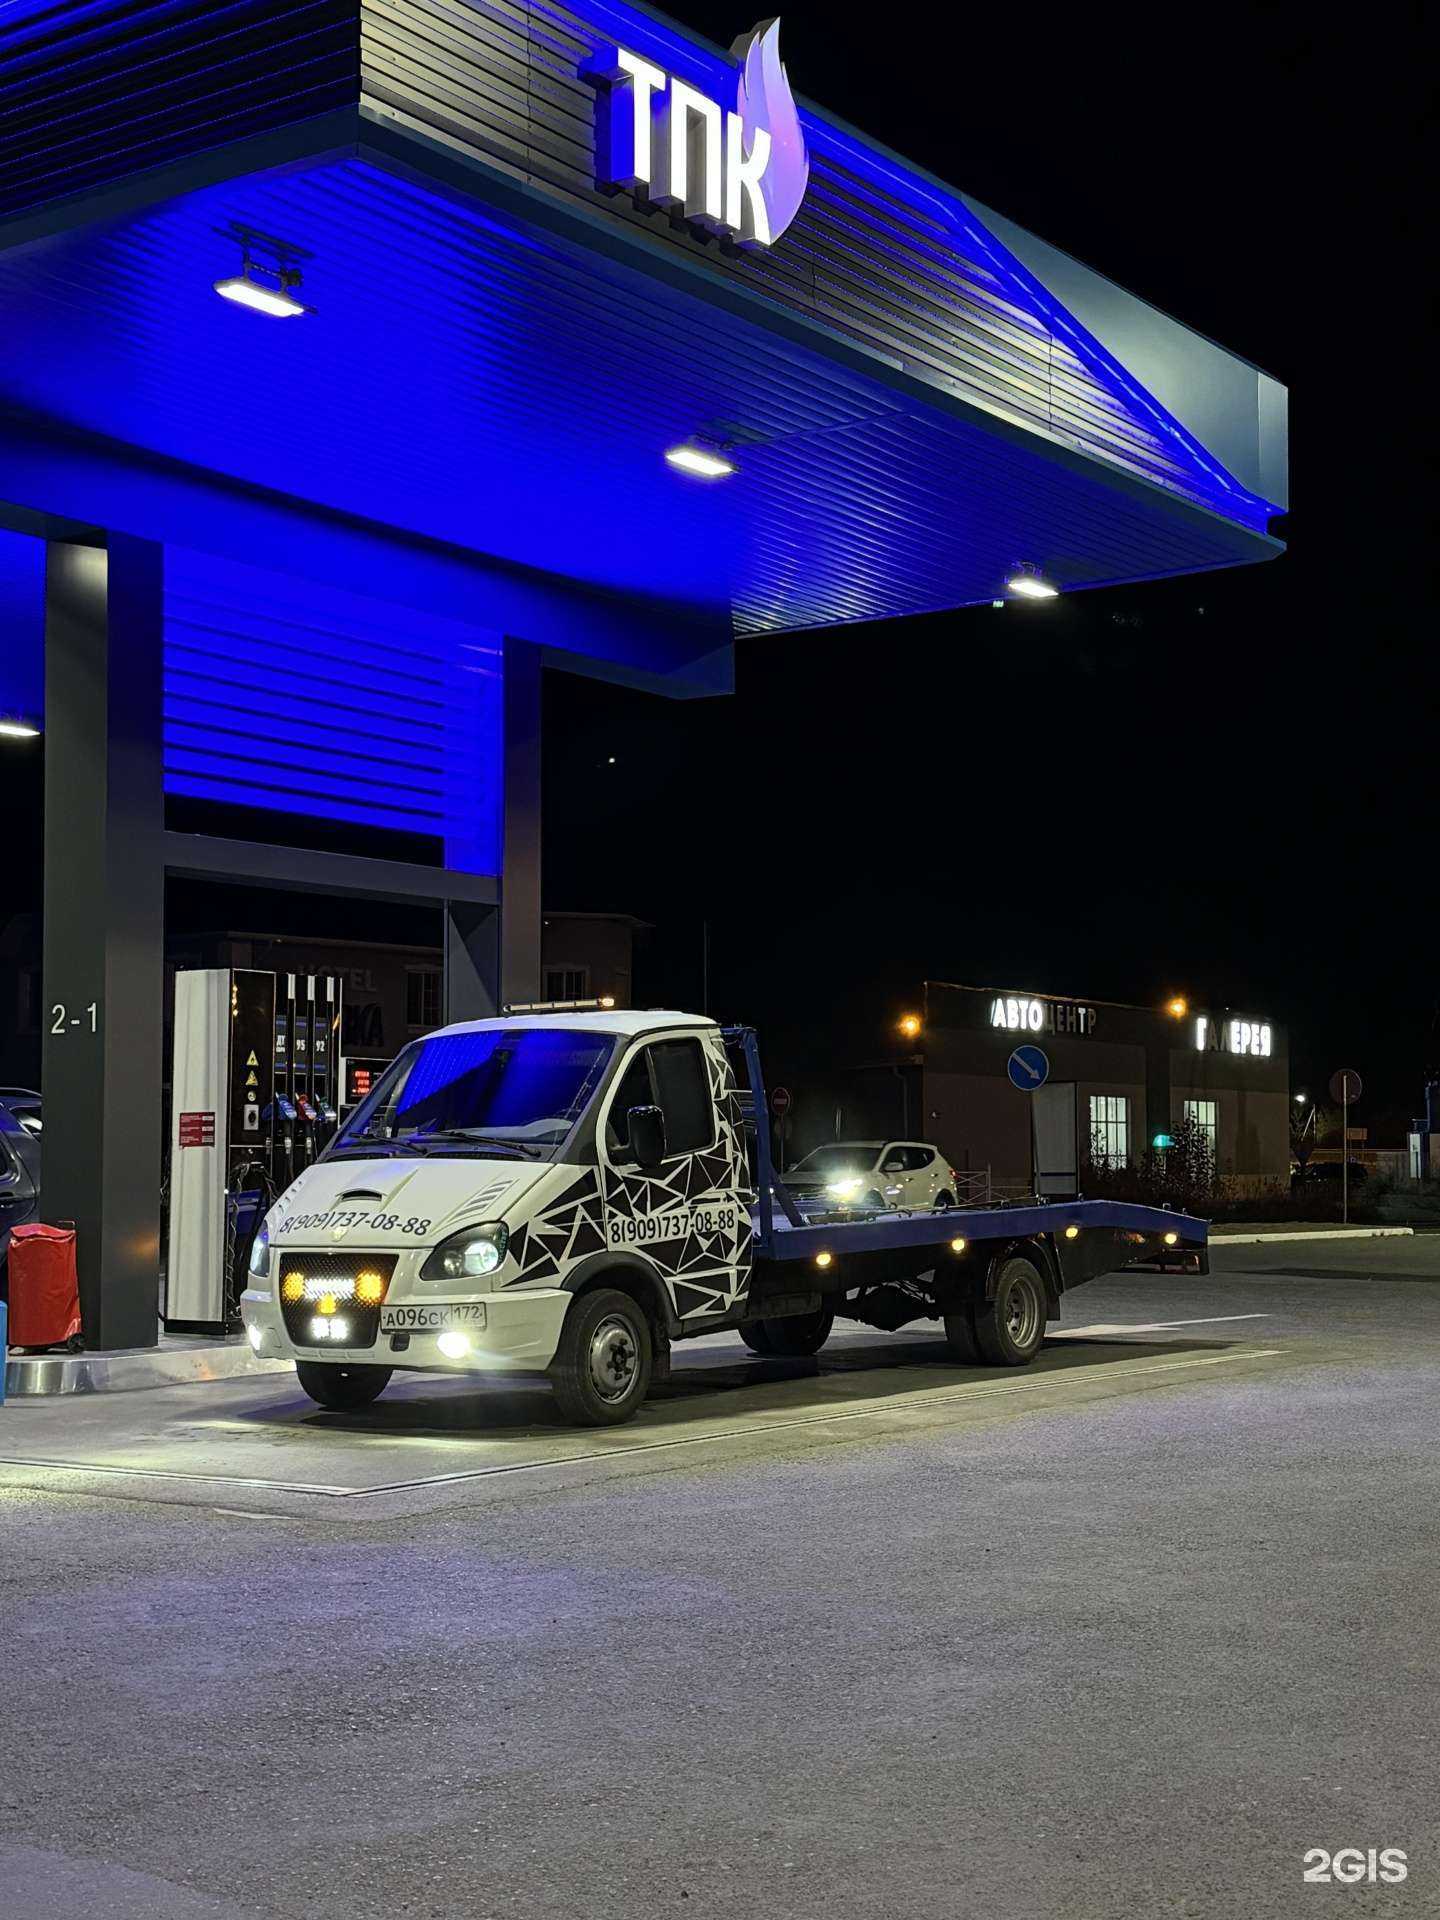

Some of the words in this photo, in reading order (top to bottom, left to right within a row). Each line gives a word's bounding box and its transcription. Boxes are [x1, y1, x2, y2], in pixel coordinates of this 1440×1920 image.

[617, 47, 772, 247] ТПК
[296, 1039, 306, 1051] 95
[315, 1040, 325, 1052] 92
[1196, 1016, 1271, 1057] ГАЛЕРЕЯ
[279, 1210, 432, 1236] 8(909)737-08-88
[611, 1208, 735, 1244] 8(909)737-08-88
[454, 1305, 480, 1320] 172
